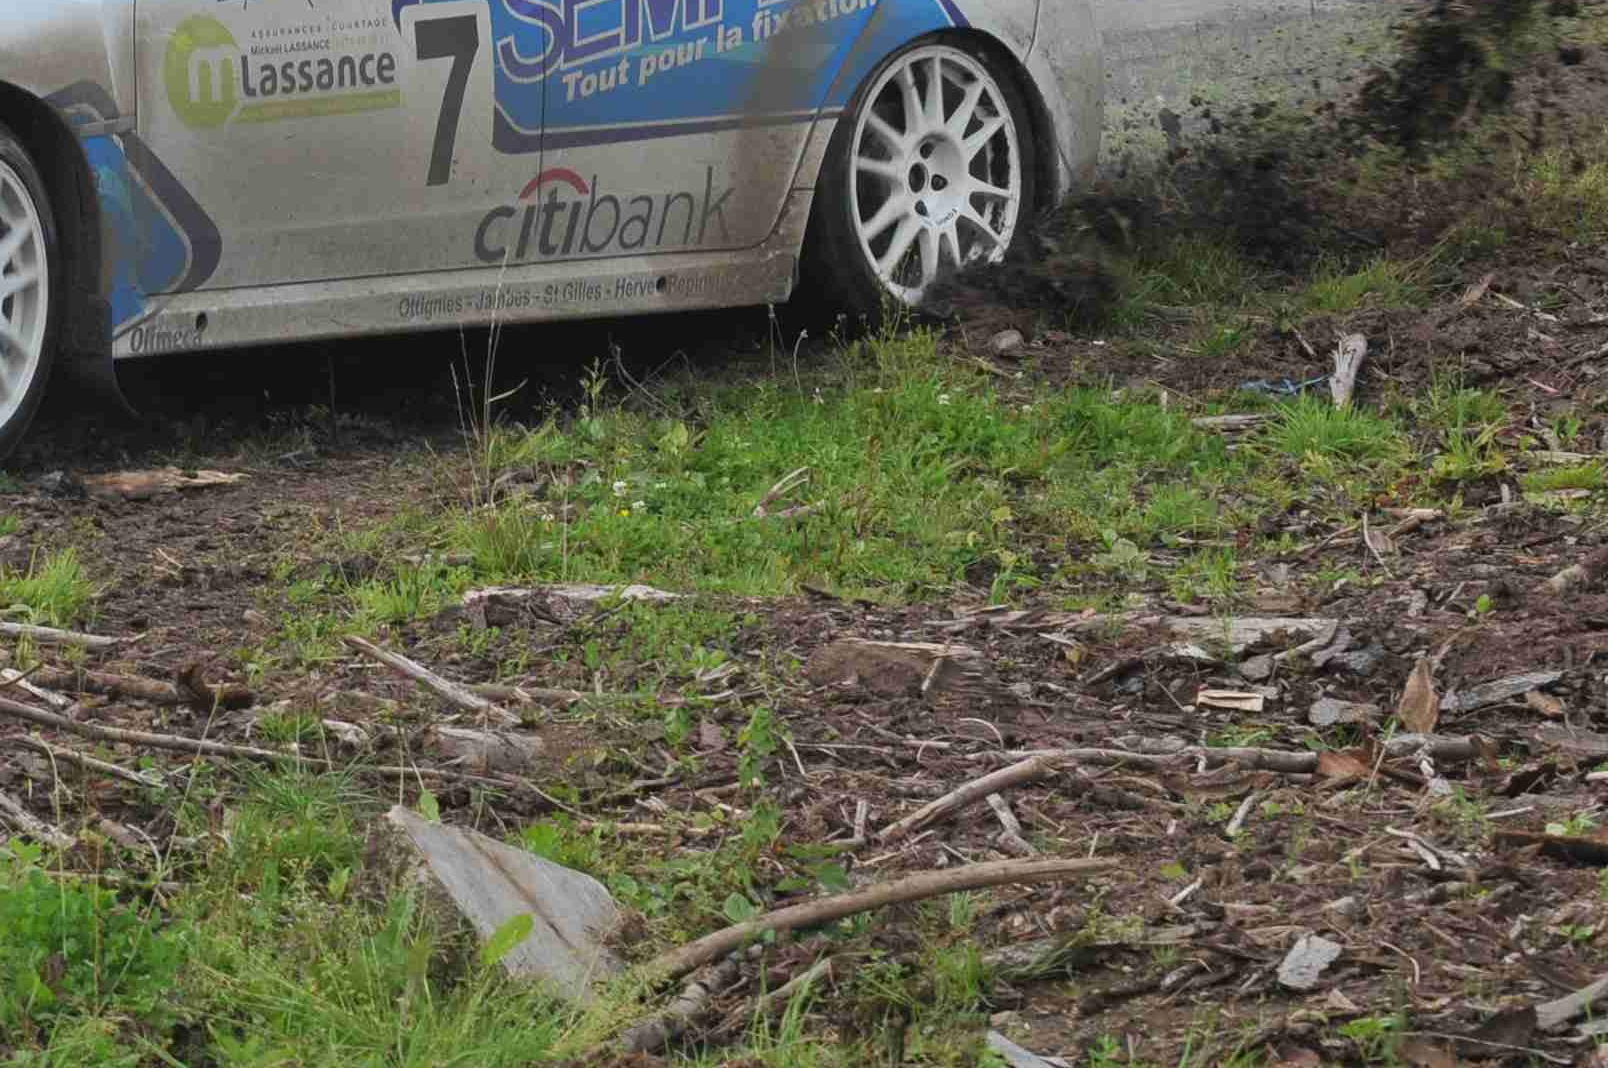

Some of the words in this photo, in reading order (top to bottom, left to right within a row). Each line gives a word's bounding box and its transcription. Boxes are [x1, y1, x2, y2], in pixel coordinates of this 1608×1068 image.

[241, 52, 395, 97] Lassance
[414, 14, 480, 187] 7
[562, 56, 630, 102] Tout
[638, 37, 708, 86] pour
[716, 23, 743, 54] la
[473, 165, 735, 264] citibank
[399, 293, 463, 320] Ottignies
[562, 279, 602, 302] Gilles
[615, 277, 656, 299] Herve
